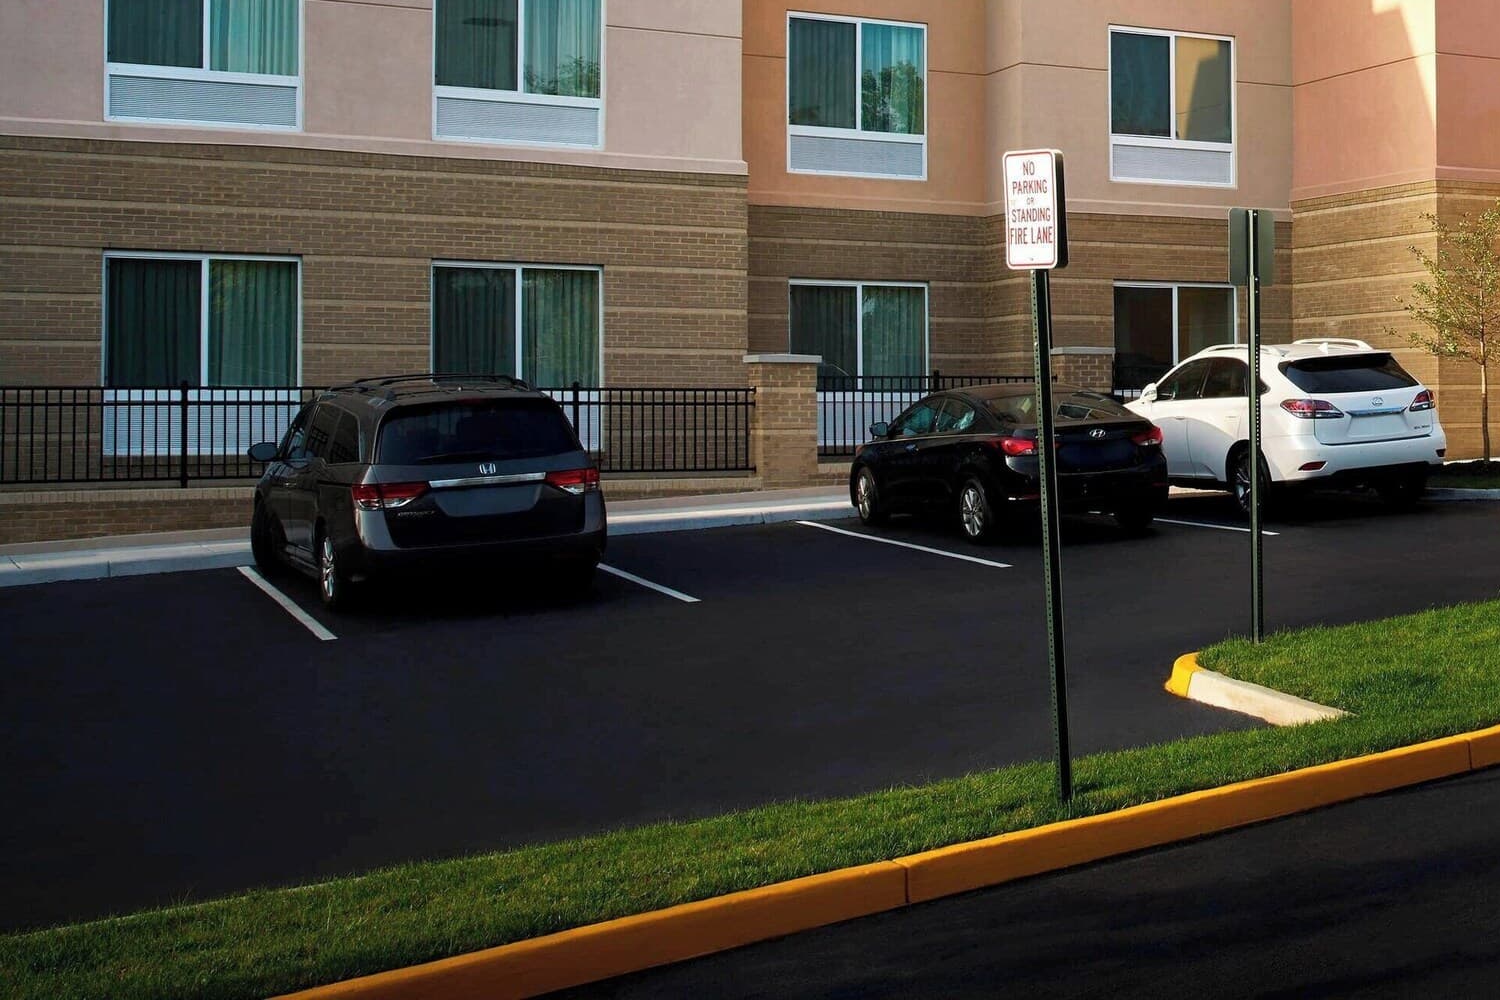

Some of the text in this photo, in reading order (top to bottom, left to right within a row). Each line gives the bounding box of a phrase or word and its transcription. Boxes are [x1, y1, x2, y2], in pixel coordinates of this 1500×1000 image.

[1022, 161, 1035, 176] NO
[1012, 180, 1048, 195] PARKING
[1011, 208, 1051, 223] STANDING
[1010, 226, 1053, 245] FIRE LANE
